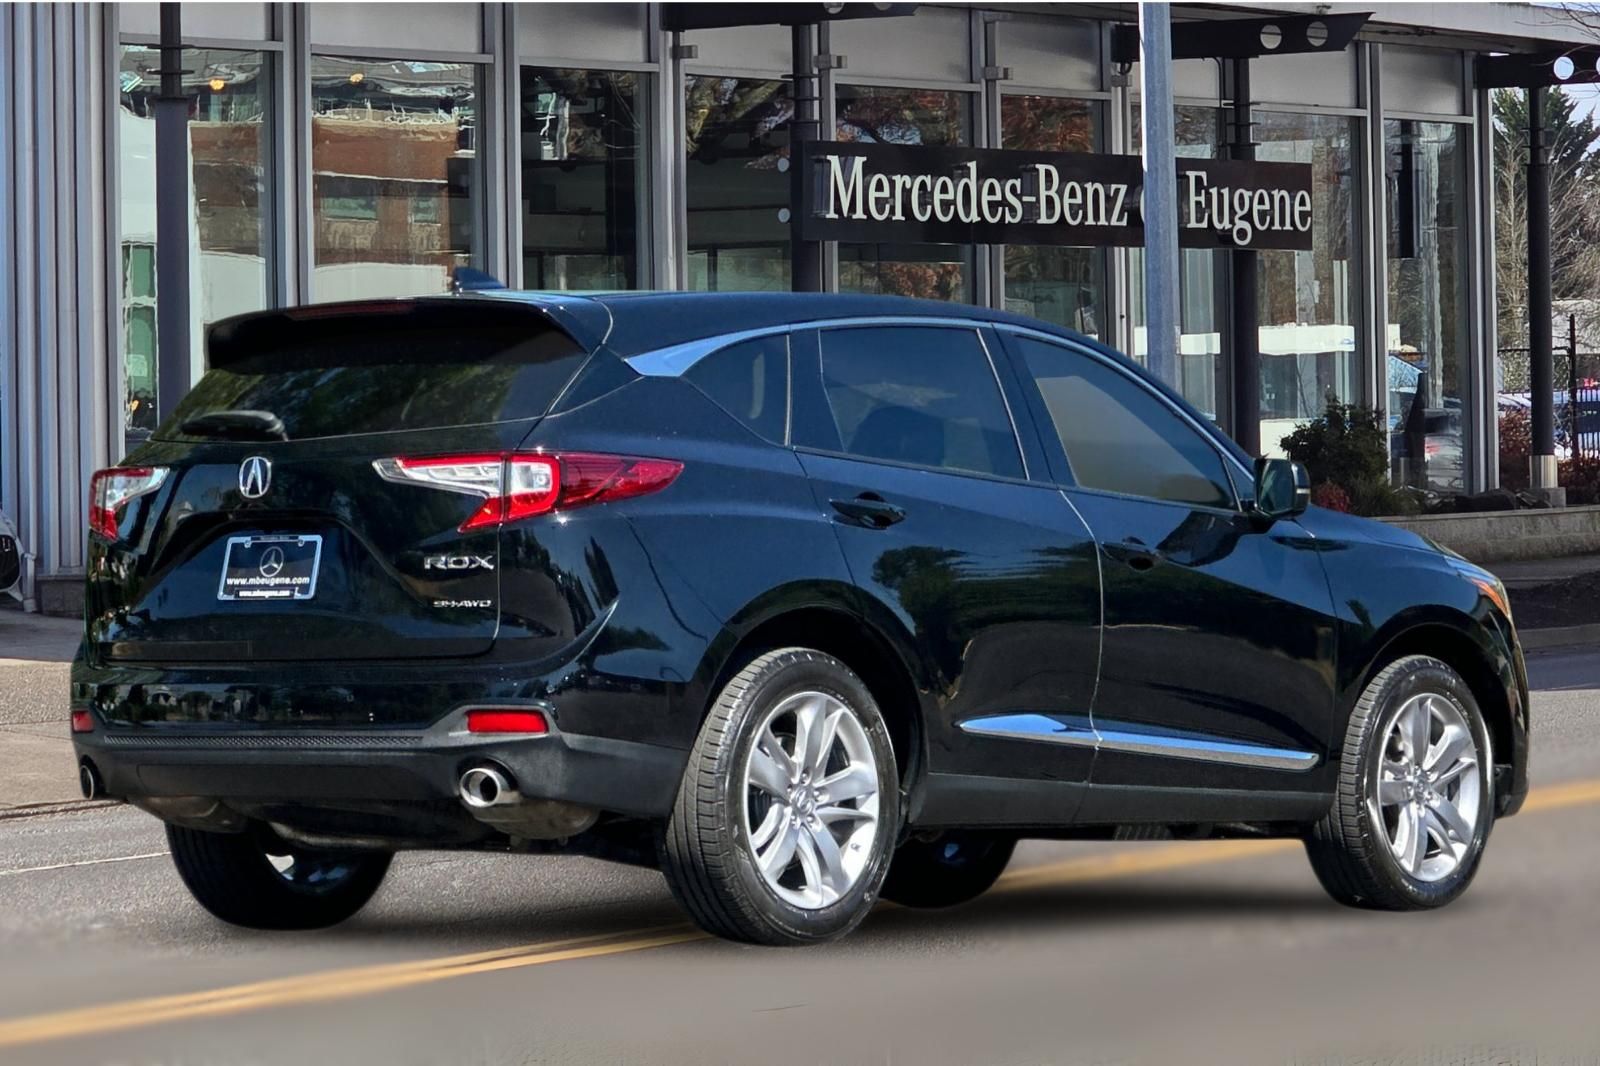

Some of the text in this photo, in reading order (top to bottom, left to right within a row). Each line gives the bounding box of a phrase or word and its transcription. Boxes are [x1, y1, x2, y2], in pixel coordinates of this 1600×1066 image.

[826, 154, 1128, 226] Mercedes-Benz
[1185, 170, 1312, 246] Eugene
[423, 555, 494, 570] RDX
[226, 576, 310, 587] www.mbeugene.com
